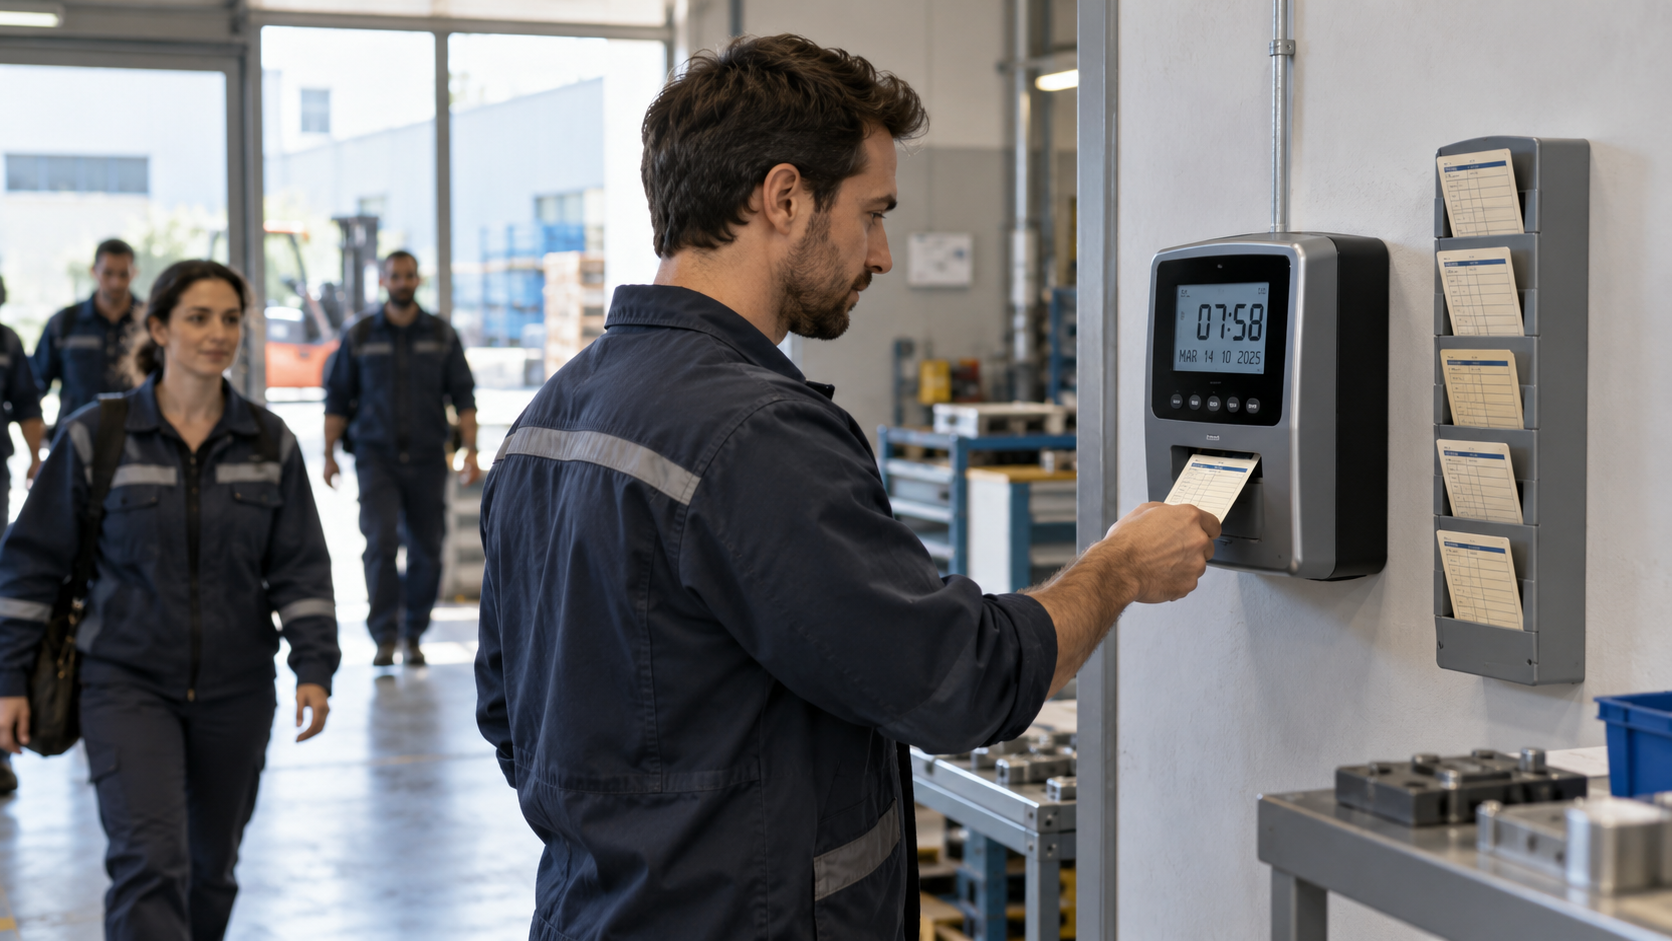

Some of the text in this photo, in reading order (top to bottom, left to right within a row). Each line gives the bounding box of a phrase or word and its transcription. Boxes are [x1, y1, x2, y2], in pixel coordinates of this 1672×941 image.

[1196, 303, 1264, 341] 07:58
[1178, 349, 1262, 365] MAR 14 10 2025
